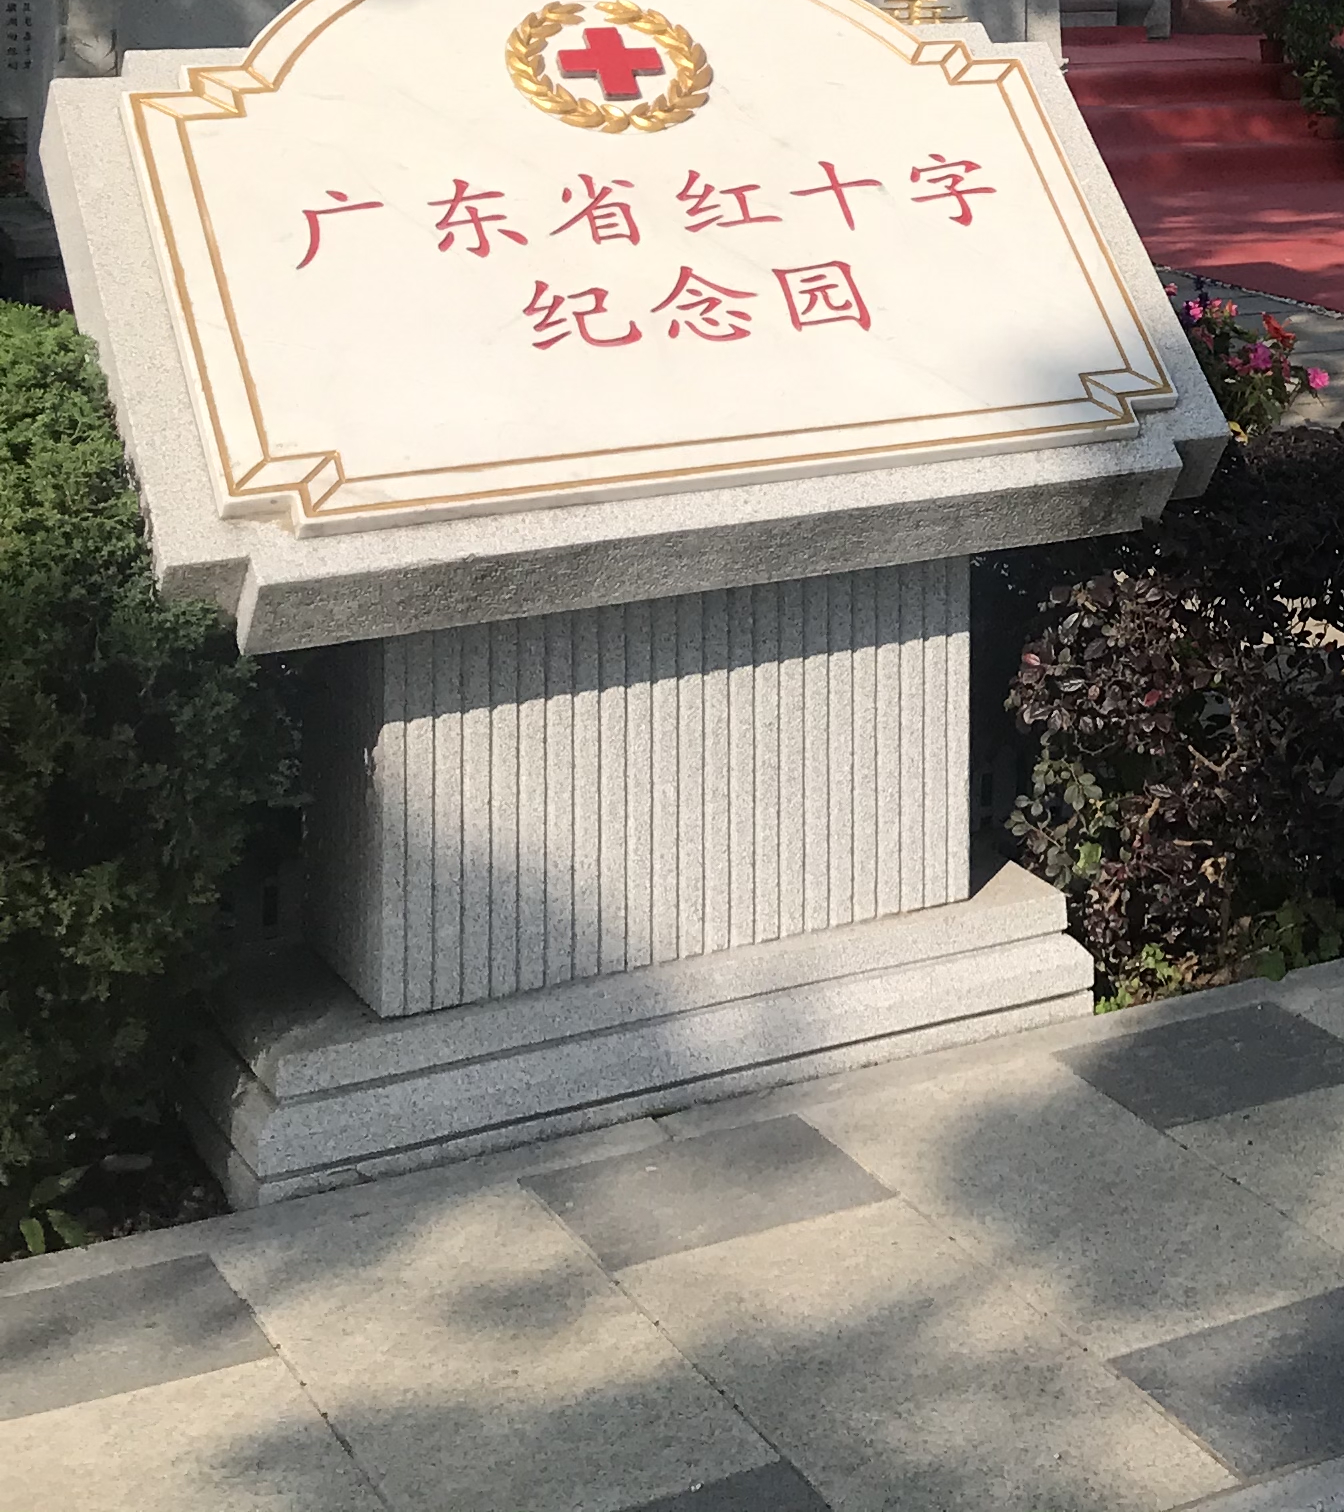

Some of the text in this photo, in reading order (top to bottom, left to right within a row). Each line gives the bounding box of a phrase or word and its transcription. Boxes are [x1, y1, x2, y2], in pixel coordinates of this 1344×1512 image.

[296, 153, 997, 270] 广东省红十字
[522, 260, 871, 351] 纪念园
